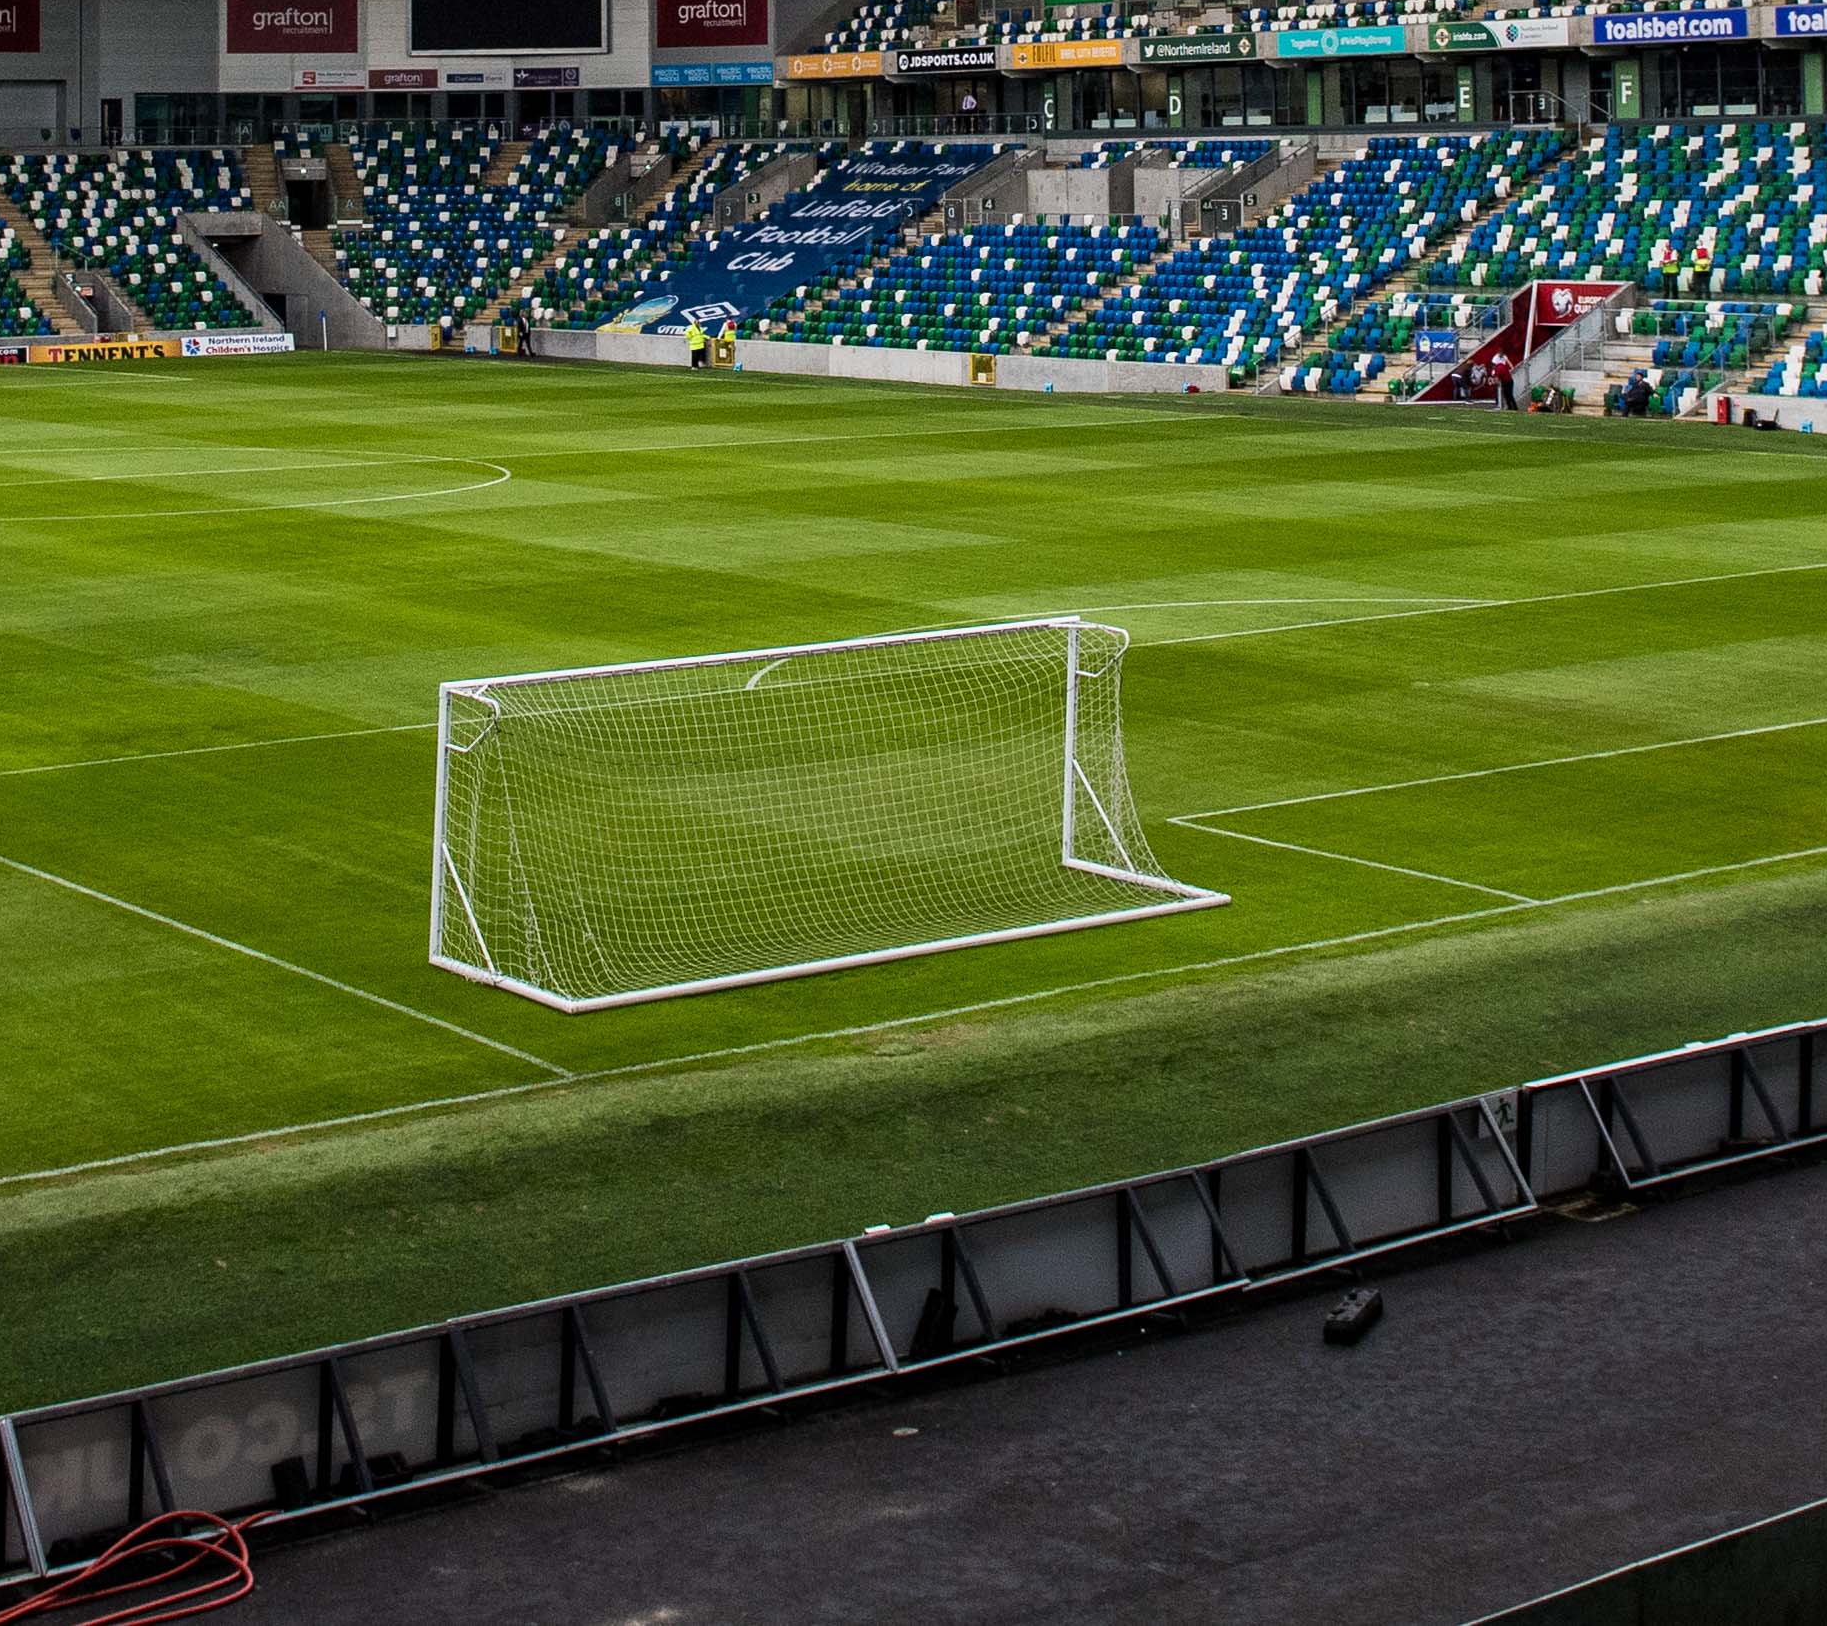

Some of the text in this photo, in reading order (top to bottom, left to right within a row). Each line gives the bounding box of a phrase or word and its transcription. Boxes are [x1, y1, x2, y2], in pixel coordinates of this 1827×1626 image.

[253, 7, 328, 31] grafton
[678, 0, 742, 24] grafton
[1605, 17, 1733, 40] toalsbet.com
[1156, 41, 1231, 56] @NorthernIreland
[909, 52, 995, 67] JDSPORTS.CO.UK
[384, 72, 420, 85] grafton
[1459, 86, 1471, 109] E
[1621, 81, 1633, 104] F
[1044, 99, 1054, 118] C
[1169, 95, 1181, 115] D
[847, 161, 976, 175] Windsor Park
[842, 178, 932, 191] home of
[790, 199, 910, 217] Linfield
[742, 225, 874, 245] Football
[726, 251, 796, 271] Club
[206, 344, 290, 354] Children's Hospice
[208, 335, 285, 345] Northern Ireland
[48, 344, 165, 363] TENNENT'S
